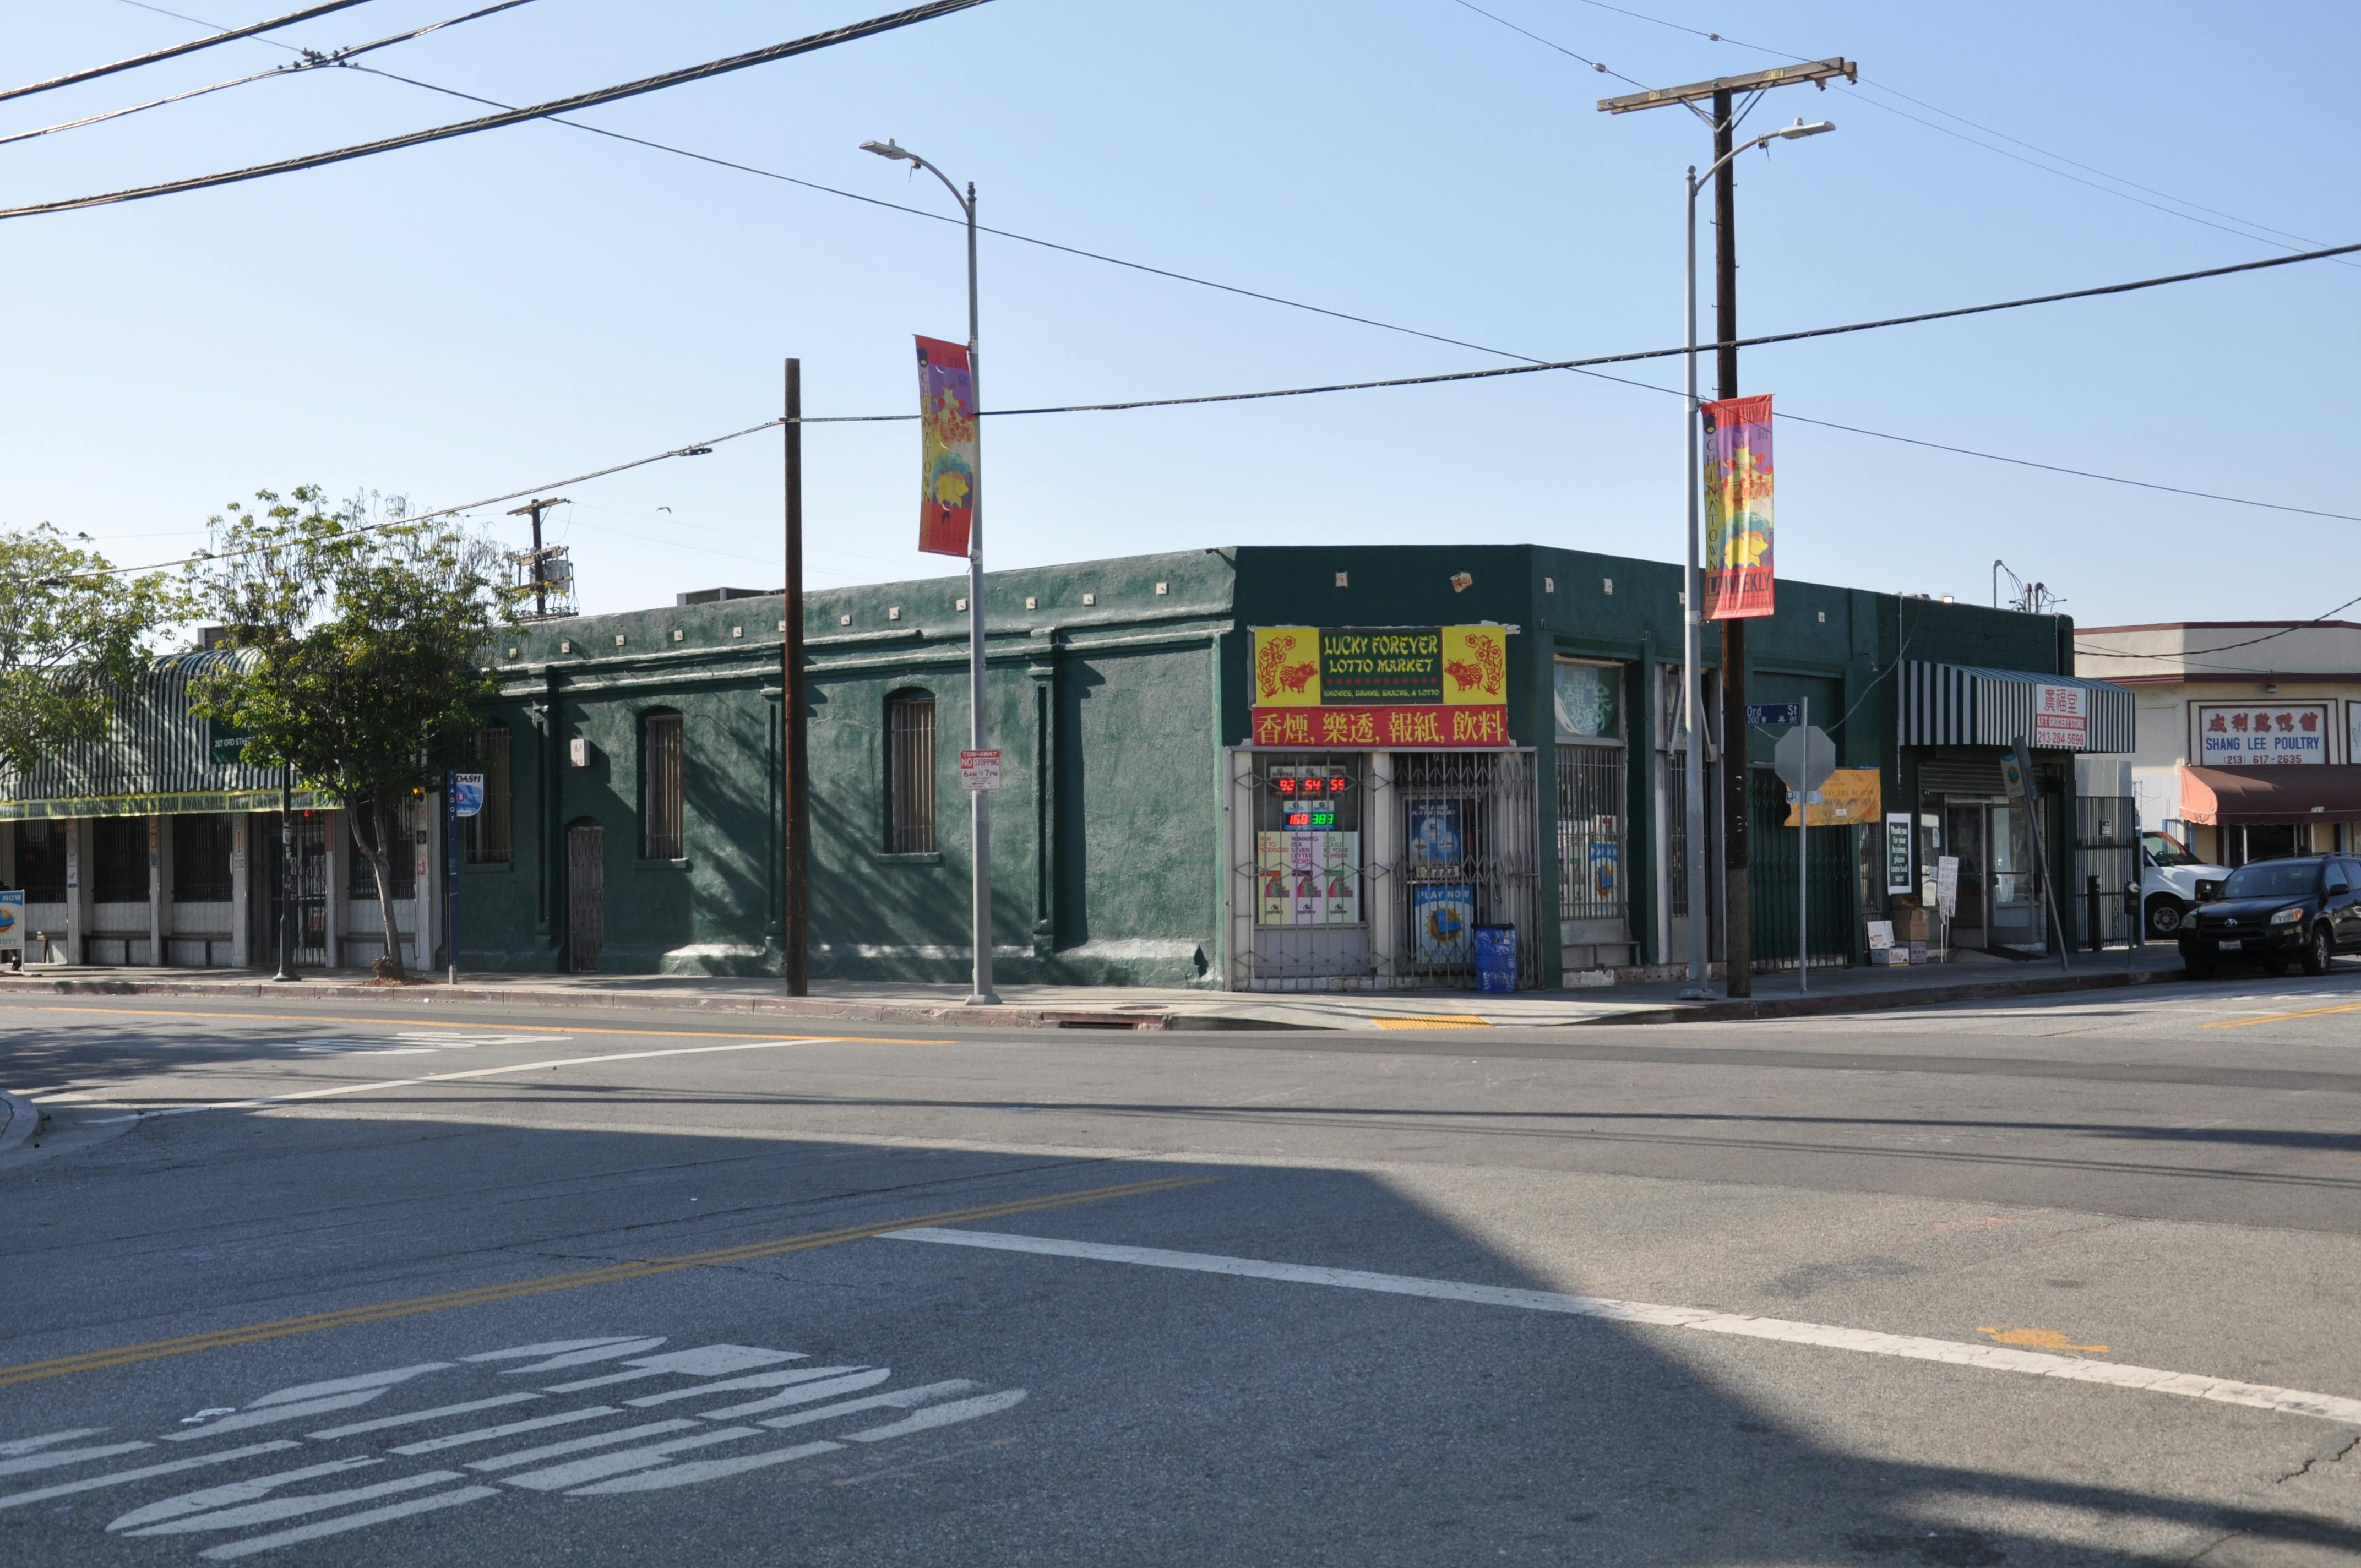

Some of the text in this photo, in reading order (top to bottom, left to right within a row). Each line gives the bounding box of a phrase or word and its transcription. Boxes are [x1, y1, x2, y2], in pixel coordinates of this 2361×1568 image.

[921, 372, 932, 503] CHINATOWN
[1706, 439, 1719, 572] CHINATOWN
[1723, 571, 1771, 595] WEEKLY
[1324, 635, 1438, 655] LUCKY FOREVER
[1329, 658, 1434, 673] LOTTO MARKET
[2045, 688, 2077, 714] 廣福堂
[1747, 705, 1797, 716] Ord St
[1452, 710, 1504, 742] 飲料
[2049, 717, 2069, 727] GROCERY
[2070, 718, 2084, 728] STORE
[215, 739, 223, 747] 207
[224, 738, 235, 747] ORD
[2038, 731, 2084, 745] 213-284-5698
[2206, 737, 2320, 750] SHANG LEE POULTRY
[961, 758, 999, 767] NO STOPPING
[2224, 755, 2246, 764] (213)
[456, 775, 481, 783] DASH
[159, 796, 178, 812] SOJU
[1312, 814, 1334, 824] 383
[1890, 826, 1901, 835] Thank
[1448, 890, 1470, 899] NOW
